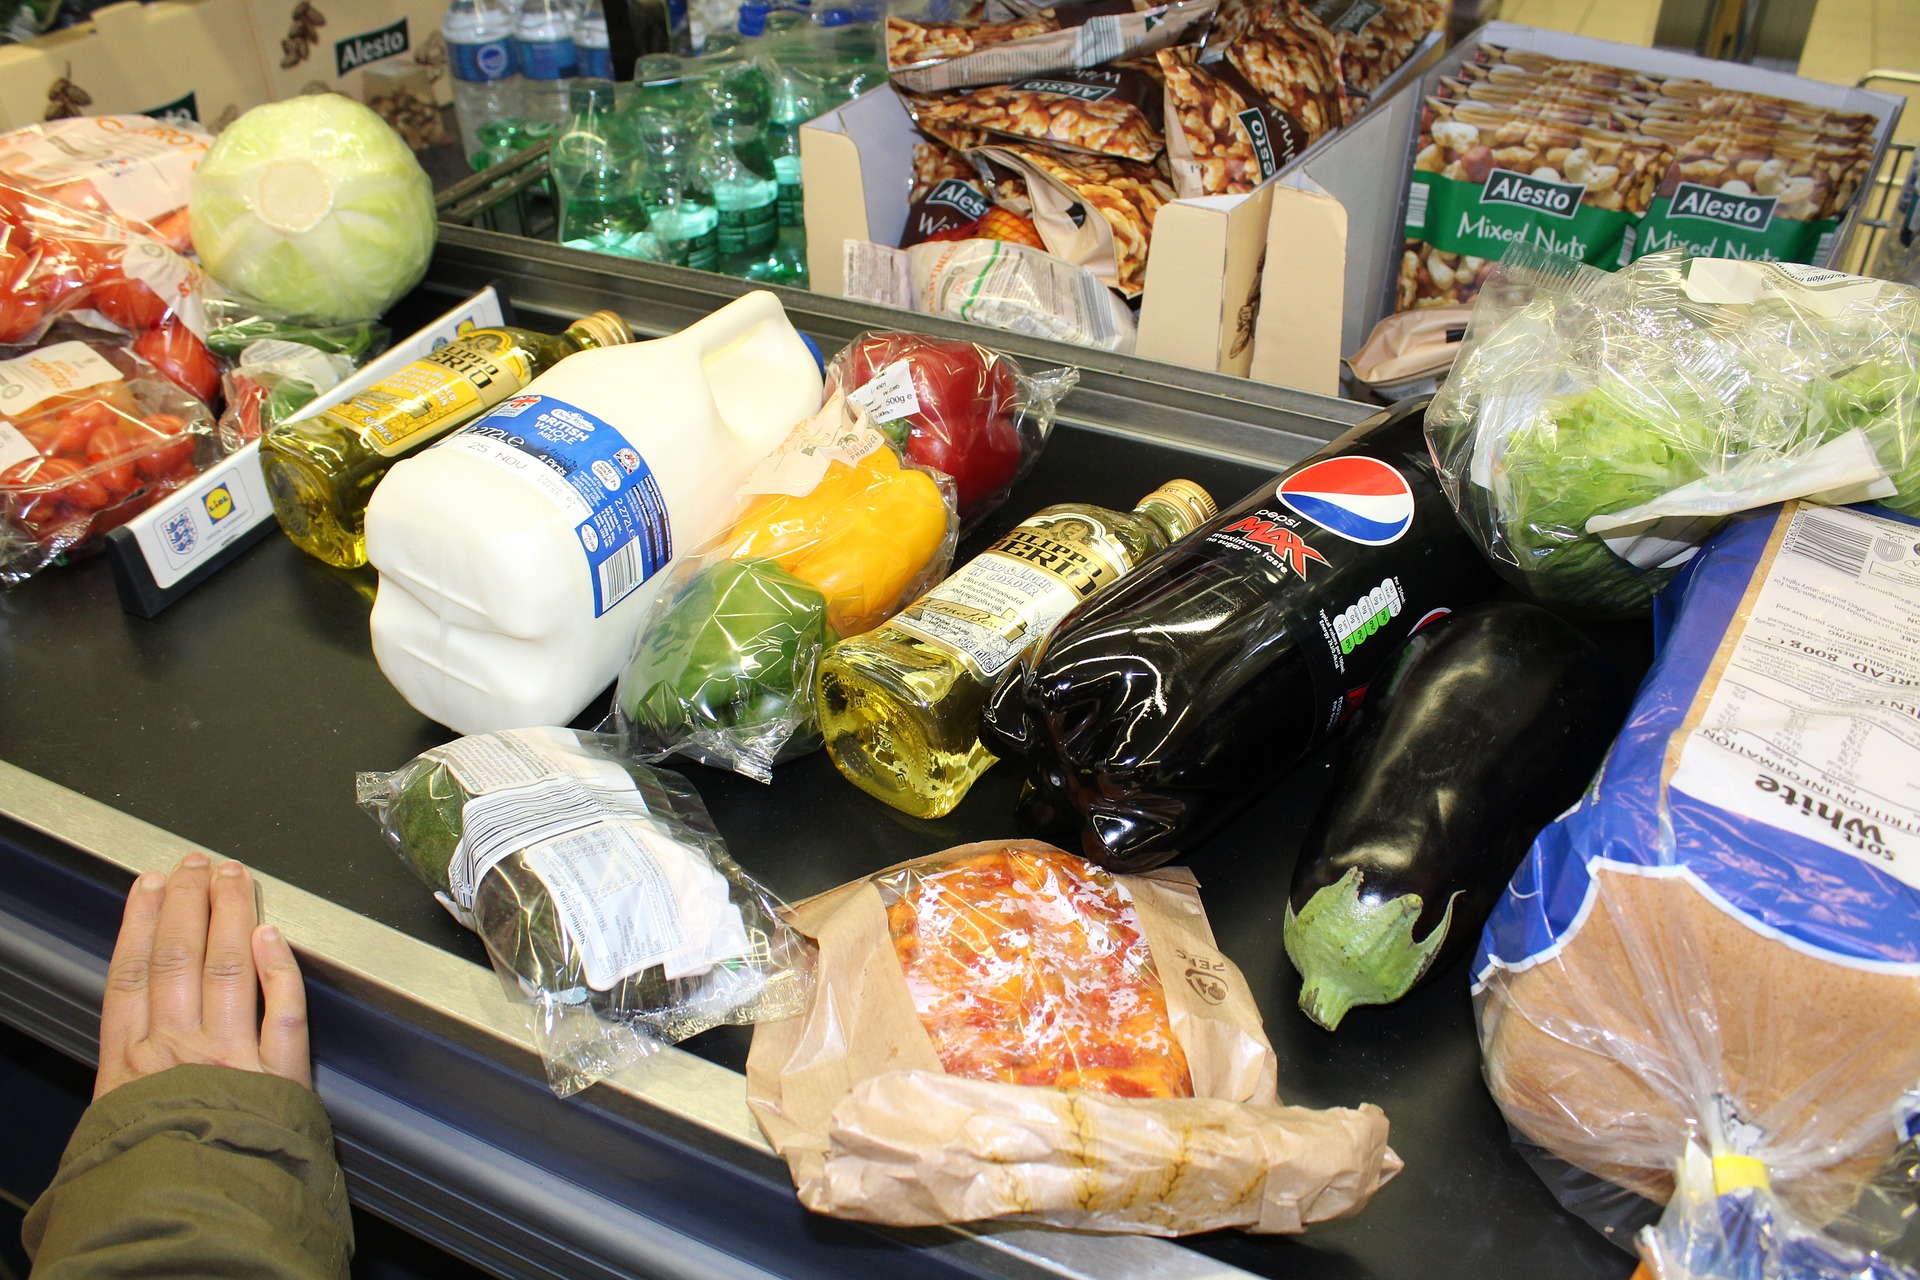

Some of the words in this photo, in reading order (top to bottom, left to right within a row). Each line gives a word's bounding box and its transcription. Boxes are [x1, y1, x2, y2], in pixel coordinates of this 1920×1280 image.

[340, 30, 404, 70] Alesto
[1024, 82, 1098, 98] Alesto
[1251, 119, 1274, 177] esto
[938, 184, 989, 214] Ales
[1491, 177, 1571, 210] Alesto
[1678, 195, 1762, 225] Alesto
[1457, 212, 1530, 241] Mixed
[1534, 226, 1587, 261] Nuts
[1643, 226, 1718, 257] Mixed
[424, 352, 492, 389] ERIO
[535, 421, 577, 445] WHOLE
[537, 413, 590, 442] BRITISH
[538, 431, 560, 443] MILK
[468, 442, 490, 452] 25
[495, 452, 527, 469] NOV
[851, 435, 878, 460] PRODUCE
[545, 458, 567, 476] Pints
[1255, 509, 1301, 528] pepsi
[1008, 532, 1102, 577] FILIPPO
[1212, 532, 1262, 554] maximum
[1262, 551, 1288, 574] taste
[1217, 539, 1244, 551] sugar
[1220, 516, 1333, 582] MAX
[973, 556, 1006, 573] MILD
[1005, 565, 1016, 575] &
[1016, 567, 1056, 593] LIGHT
[988, 539, 1097, 595] BERIO
[964, 577, 979, 585] Olive
[987, 584, 1017, 601] composed
[986, 572, 1039, 597] COLOUR
[1772, 577, 1784, 585] For
[1780, 575, 1801, 588] rights.
[960, 590, 977, 602] virgin
[977, 597, 992, 608] olive
[992, 603, 1002, 612] oils
[961, 584, 980, 594] refined
[980, 589, 995, 601] olive
[996, 596, 1006, 605] oils
[1372, 596, 1379, 605] 0g
[1816, 595, 1838, 606] Friday
[1831, 594, 1847, 604] your
[1853, 580, 1911, 605] @KingsmillCare
[1352, 607, 1361, 623] Sugars
[1360, 605, 1367, 614] 0g
[1364, 596, 1373, 616] Saturates
[1775, 602, 1790, 612] and
[1845, 606, 1872, 622] Monday
[1847, 601, 1866, 613] affect
[1866, 610, 1878, 618] not
[1317, 608, 1331, 627] Typical
[1328, 627, 1338, 645] values
[1349, 614, 1355, 624] 0g
[1753, 616, 1776, 627] ideally
[1766, 616, 1795, 629] reduced.
[1790, 609, 1825, 626] purchase
[1878, 615, 1894, 624] does
[1318, 619, 1330, 639] Energy
[1336, 623, 1343, 633] 0g
[1781, 627, 1799, 636] place
[1800, 632, 1812, 640] dry
[1806, 630, 1821, 638] may
[1826, 623, 1844, 632] after
[956, 637, 977, 650] 500
[1827, 629, 1874, 647] FREEZING
[1826, 646, 1859, 659] FRESH!
[1876, 645, 1907, 658] HOME
[1851, 661, 1919, 688] READ
[1861, 656, 1916, 679] KINGSMILL
[1701, 728, 1831, 796] INFORMATION
[1785, 756, 1798, 767] Per
[1843, 831, 1896, 861] soft
[568, 911, 588, 945] Nutrition
